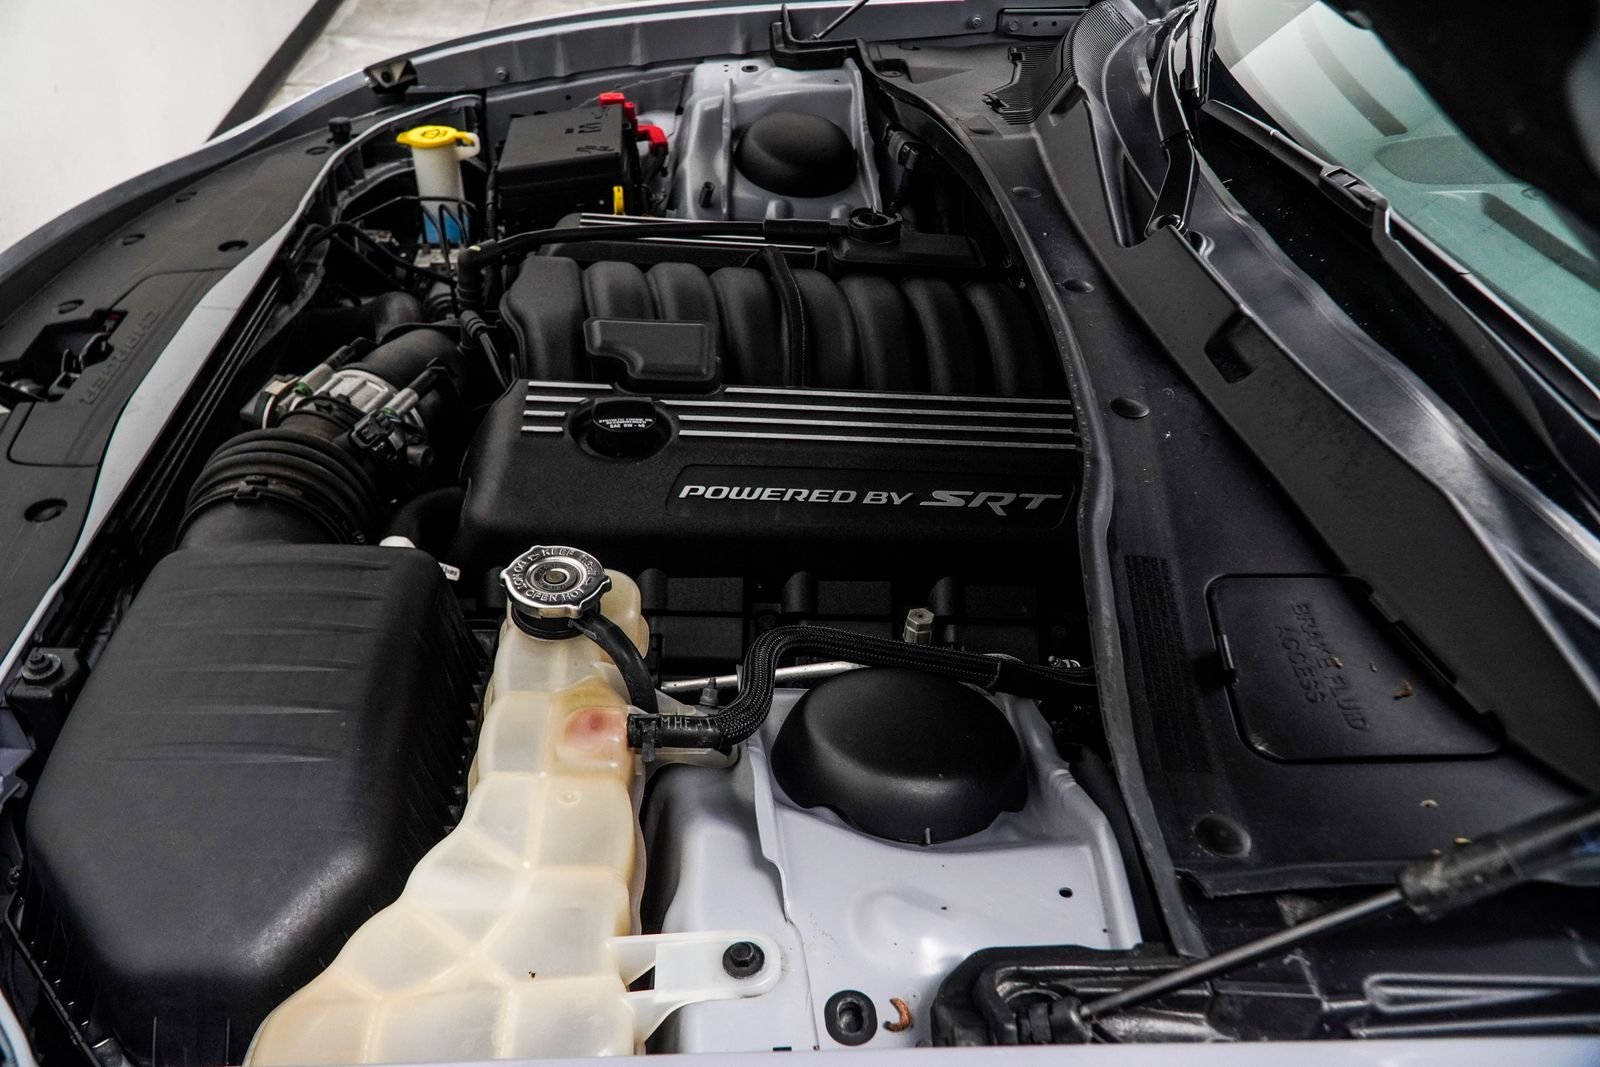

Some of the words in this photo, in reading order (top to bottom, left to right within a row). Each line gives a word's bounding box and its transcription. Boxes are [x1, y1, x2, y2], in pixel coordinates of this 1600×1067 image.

[678, 484, 857, 503] POWERED
[862, 490, 913, 505] BY
[919, 489, 1063, 517] SRT
[541, 548, 576, 557] KEEP
[512, 573, 528, 590] NOT
[525, 589, 558, 602] OPEN
[562, 587, 585, 601] HOT
[1274, 625, 1326, 704] ACCESS
[1290, 602, 1336, 669] BRAKE
[1323, 673, 1368, 730] FLUID
